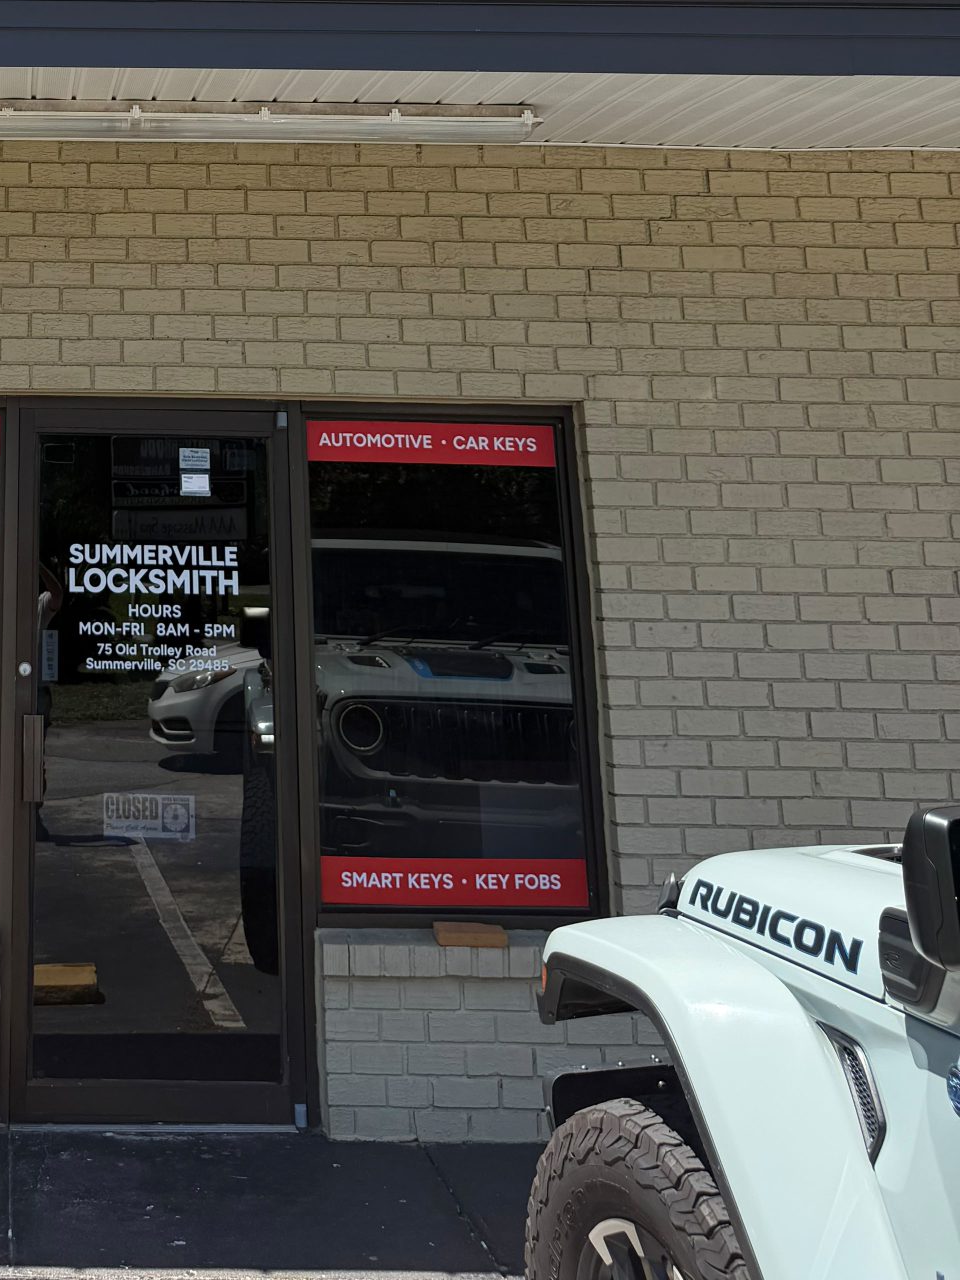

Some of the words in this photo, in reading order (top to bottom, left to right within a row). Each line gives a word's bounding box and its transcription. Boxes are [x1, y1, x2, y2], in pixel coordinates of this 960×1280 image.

[318, 432, 433, 449] AUTOMOTIVE
[453, 435, 489, 450] CAR
[493, 436, 537, 452] KEYS
[69, 543, 238, 567] SUMMERVILLE
[68, 567, 239, 596] LOCKSMITH
[128, 603, 182, 618] HOURS
[79, 621, 145, 636] MON-FRI
[156, 622, 190, 637] 8AM
[204, 623, 235, 638] 5PM
[96, 642, 113, 655] 75
[115, 643, 138, 656] Old
[139, 643, 183, 659] Trolley
[185, 644, 217, 657] Road
[85, 657, 165, 672] Summerville,
[167, 658, 186, 671] SC
[188, 659, 229, 671] 29485
[105, 795, 159, 821] CLOSED
[341, 871, 404, 889] SMART
[408, 873, 454, 889] KEYS
[475, 873, 510, 889] KEY
[514, 873, 561, 890] FOBS
[688, 877, 865, 975] RUBICON
